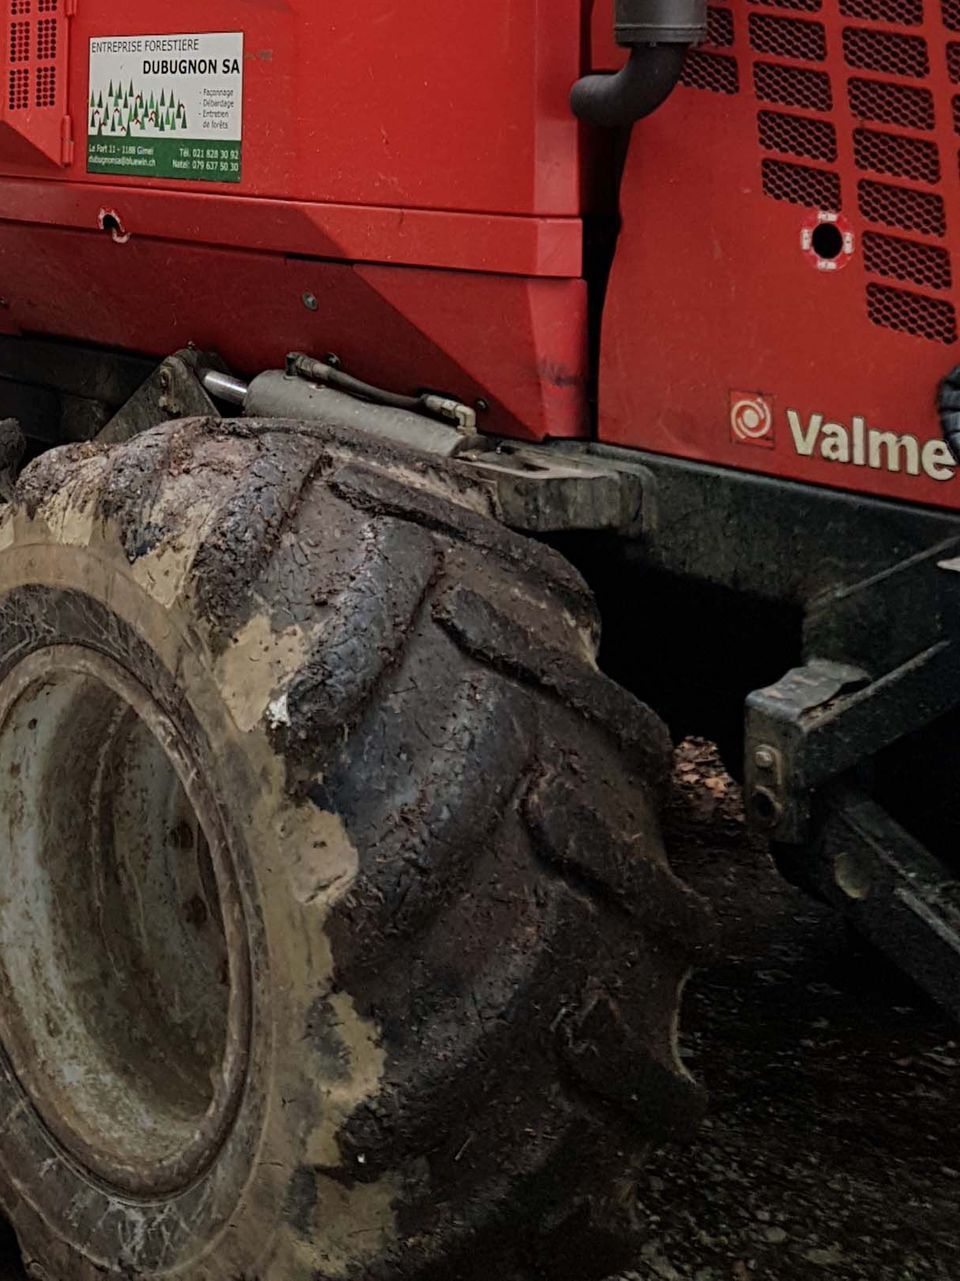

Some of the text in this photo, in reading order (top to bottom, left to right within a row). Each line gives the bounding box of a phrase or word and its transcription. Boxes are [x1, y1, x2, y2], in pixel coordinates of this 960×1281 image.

[91, 38, 200, 53] ENTREPRISE FORESTIERE
[143, 59, 240, 75] DUBUGNON SA
[192, 148, 204, 159] 021
[192, 160, 205, 170] 079
[785, 409, 957, 482] Valme
